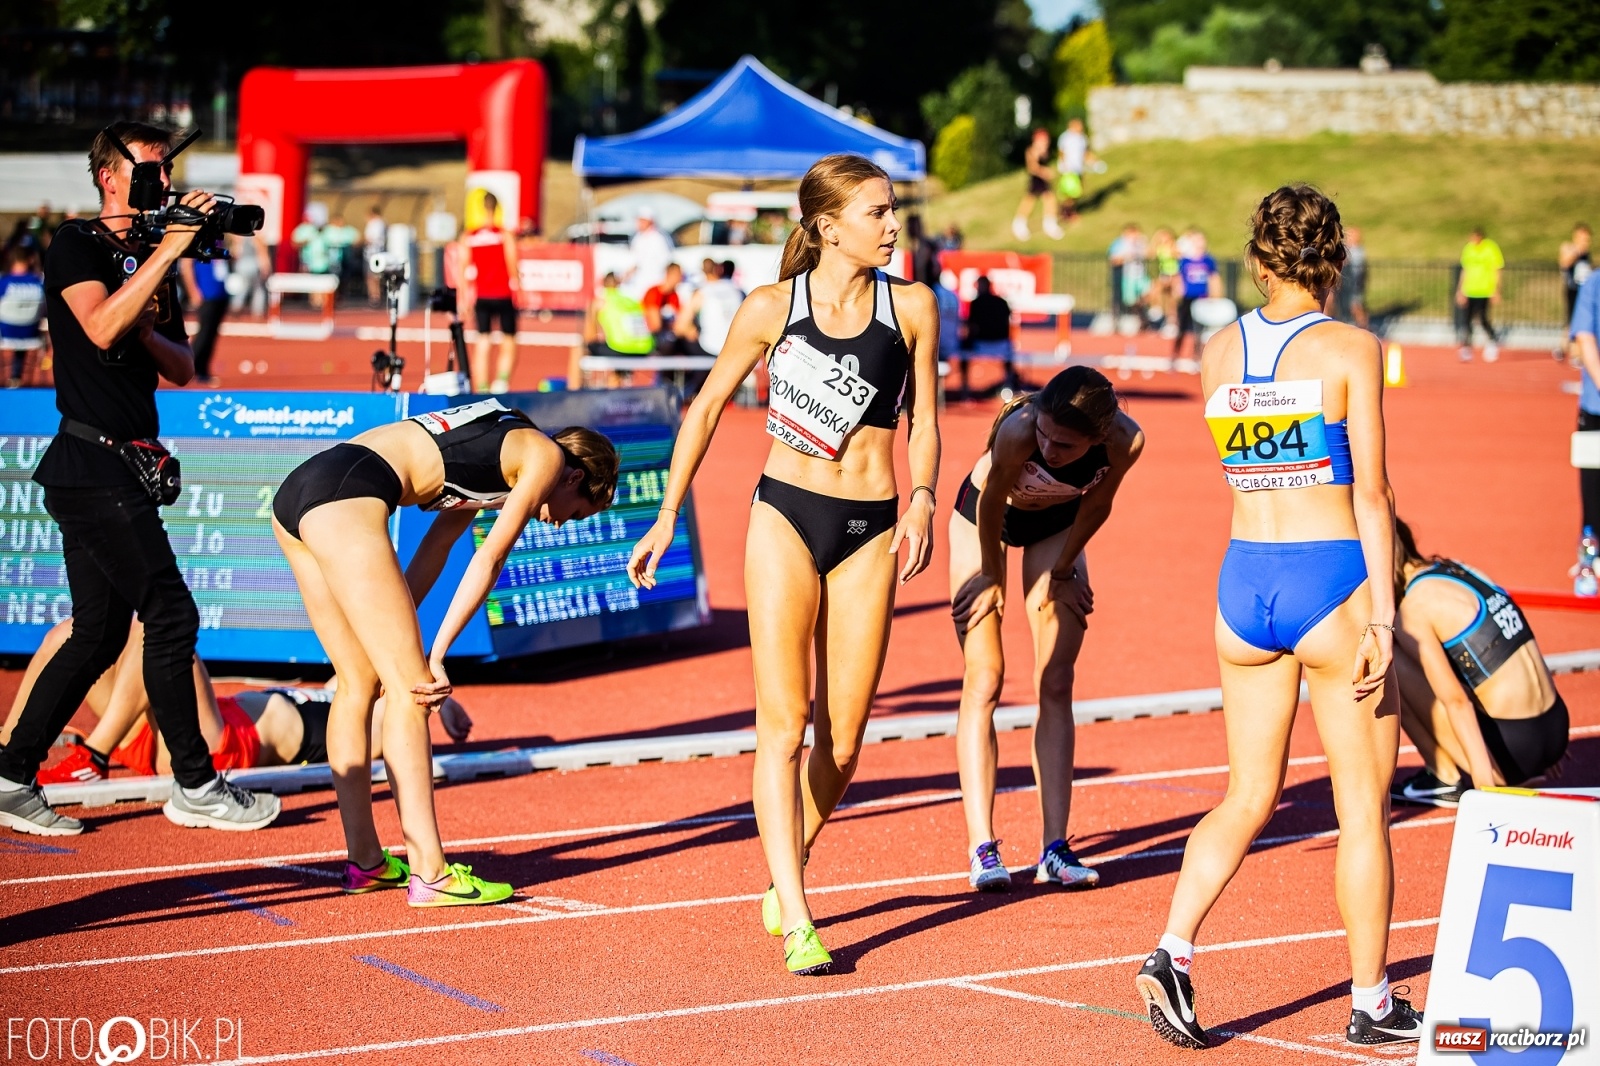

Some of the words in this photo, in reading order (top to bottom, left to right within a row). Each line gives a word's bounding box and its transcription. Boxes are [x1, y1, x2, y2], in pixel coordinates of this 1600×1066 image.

[822, 368, 870, 406] 253
[1253, 396, 1296, 407] Racibórz
[235, 406, 354, 428] domtel-sport.pl
[1225, 419, 1308, 460] 484
[1287, 473, 1317, 487] 2019
[1505, 828, 1575, 850] polanik
[1458, 863, 1574, 1066] 5
